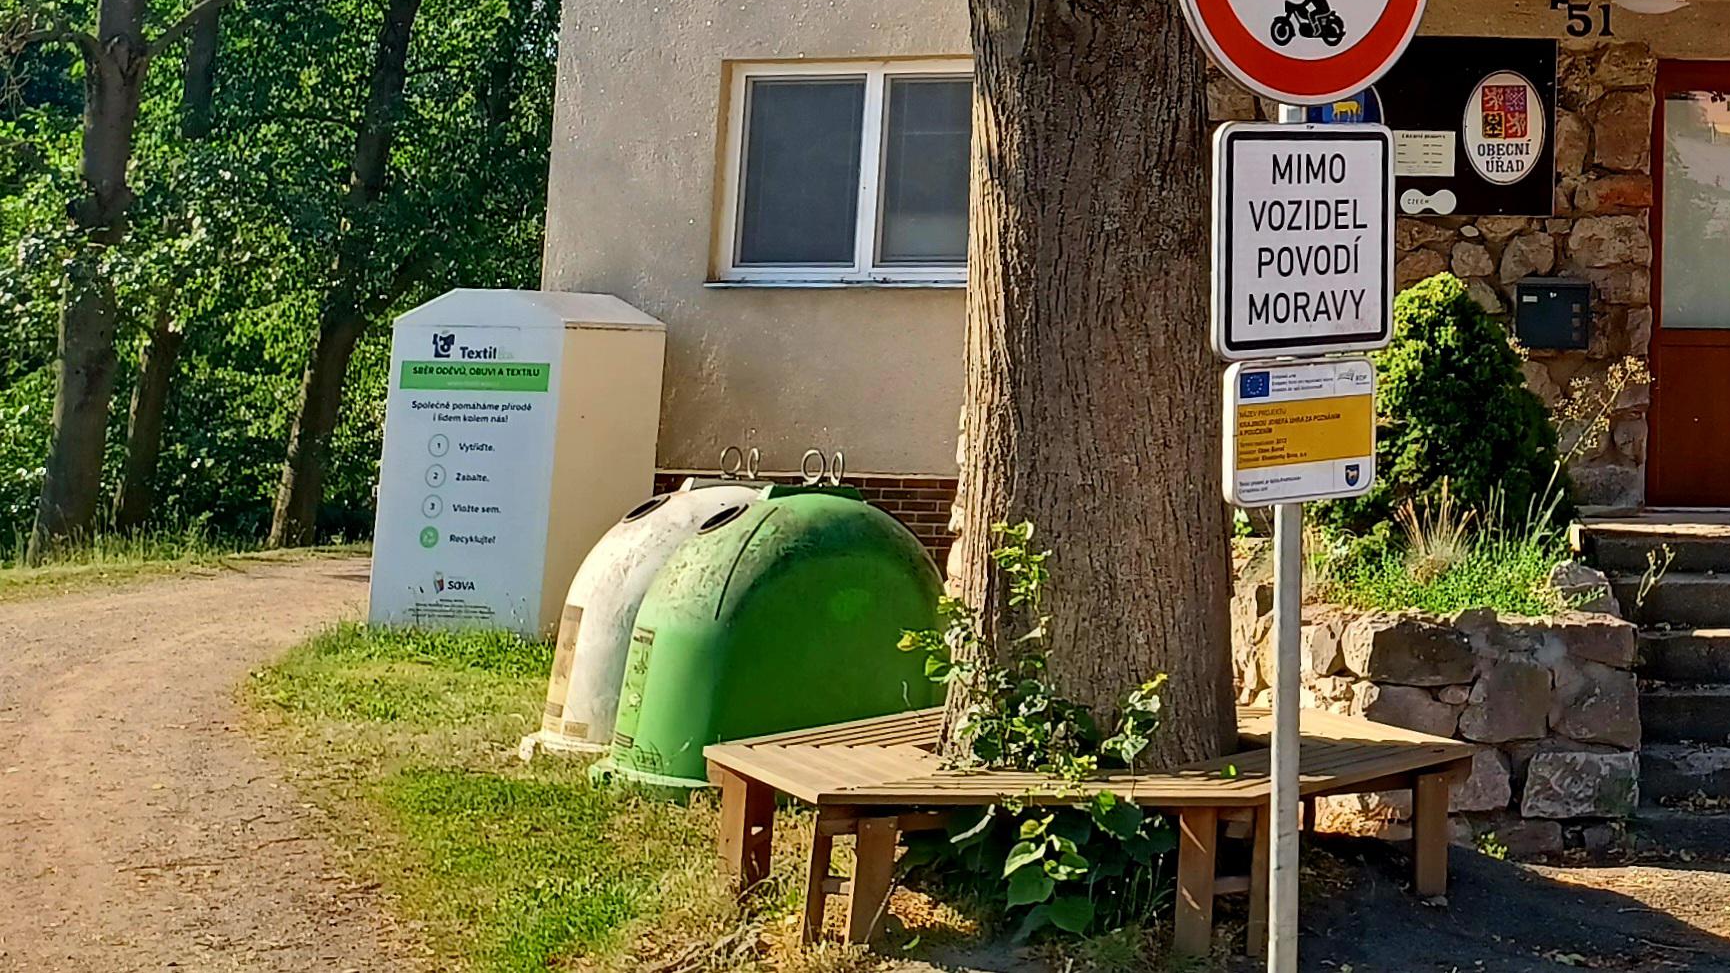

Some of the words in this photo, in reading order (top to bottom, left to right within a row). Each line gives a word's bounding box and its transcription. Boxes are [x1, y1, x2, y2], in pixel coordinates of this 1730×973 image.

[1566, 1, 1614, 37] 51
[1477, 139, 1532, 156] OBECNÍ
[1272, 153, 1346, 184] MIMO
[1485, 156, 1525, 173] ÚŘAD
[1248, 199, 1368, 232] VOZIDEL
[1257, 235, 1362, 278] POVODÍ
[1248, 288, 1366, 325] MORAVY
[412, 365, 434, 375] SBĚR
[497, 368, 504, 376] A
[505, 368, 540, 377] TEXTILU
[411, 400, 451, 410] Společně
[452, 401, 500, 411] pomáháme
[463, 413, 489, 423] kolem
[433, 472, 439, 480] 2
[430, 502, 436, 511] 3
[447, 580, 476, 591] SOVA
